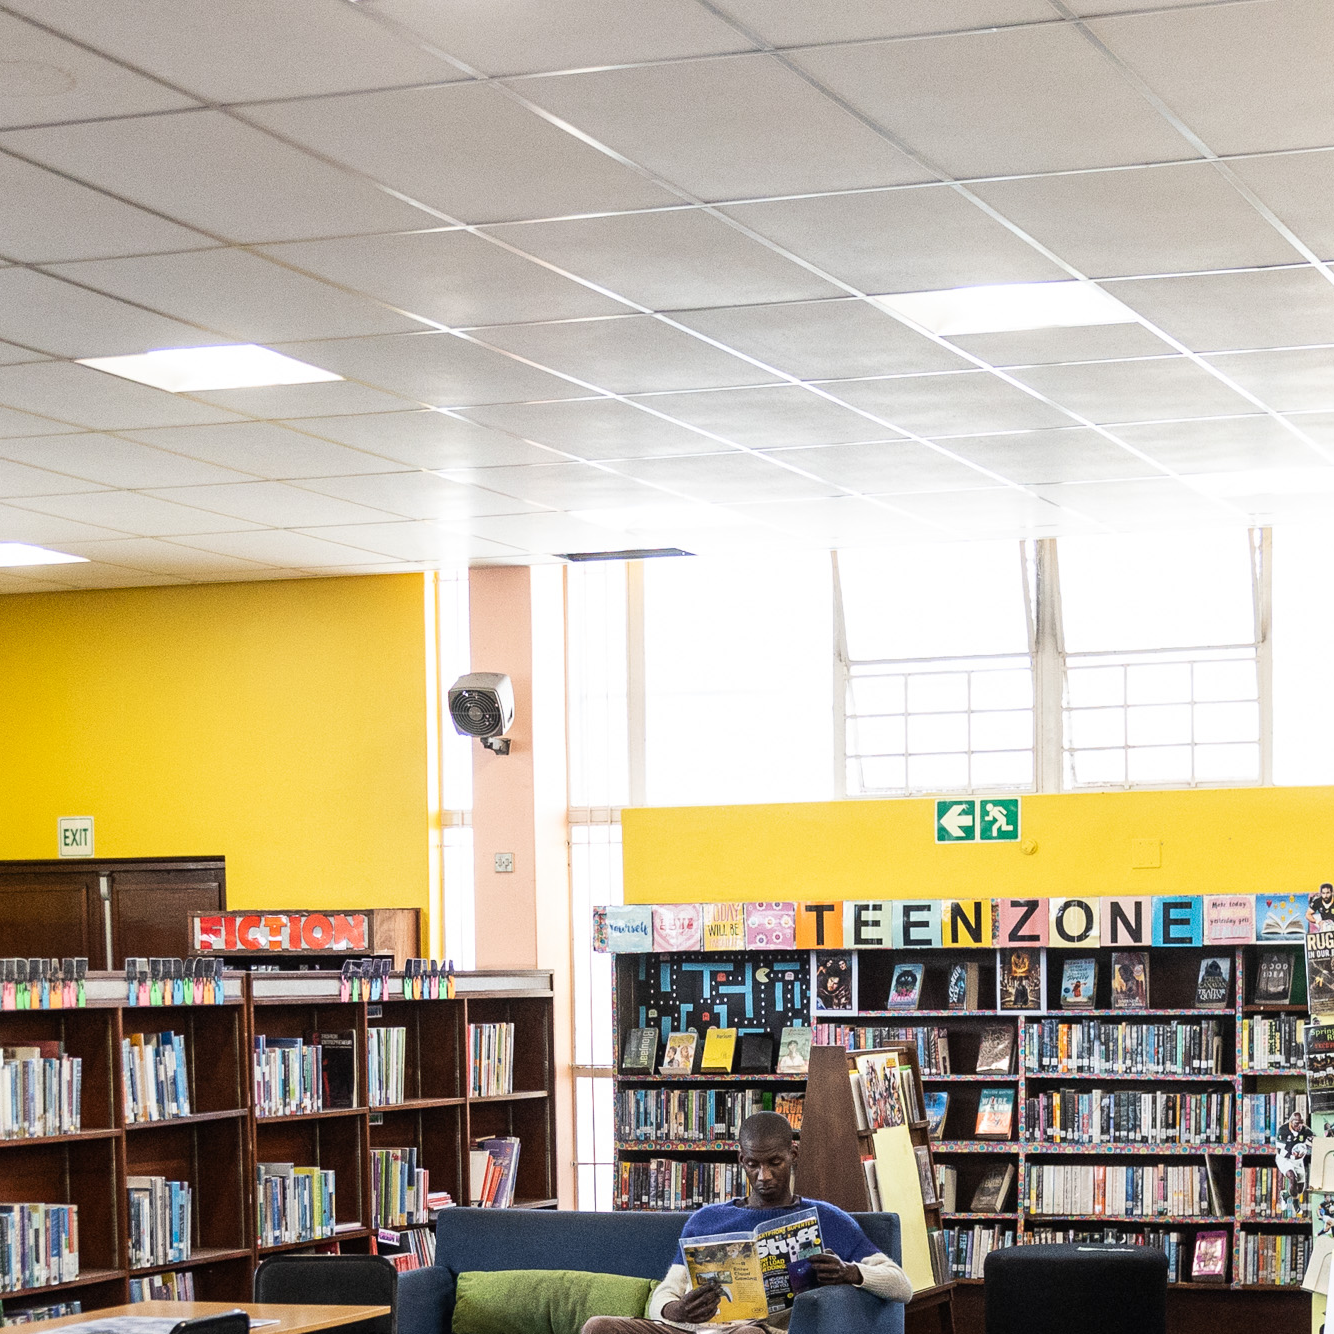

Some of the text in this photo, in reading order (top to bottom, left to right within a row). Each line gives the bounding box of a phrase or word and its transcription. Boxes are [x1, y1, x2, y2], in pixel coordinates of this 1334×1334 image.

[63, 827, 88, 847] EXIT
[1228, 901, 1247, 909] today
[200, 914, 364, 949] FICTION
[709, 923, 740, 937] WILL BE
[1307, 951, 1316, 959] IN
[1316, 949, 1331, 959] OUR
[757, 1226, 818, 1258] Stuff
[767, 1255, 777, 1263] TO
